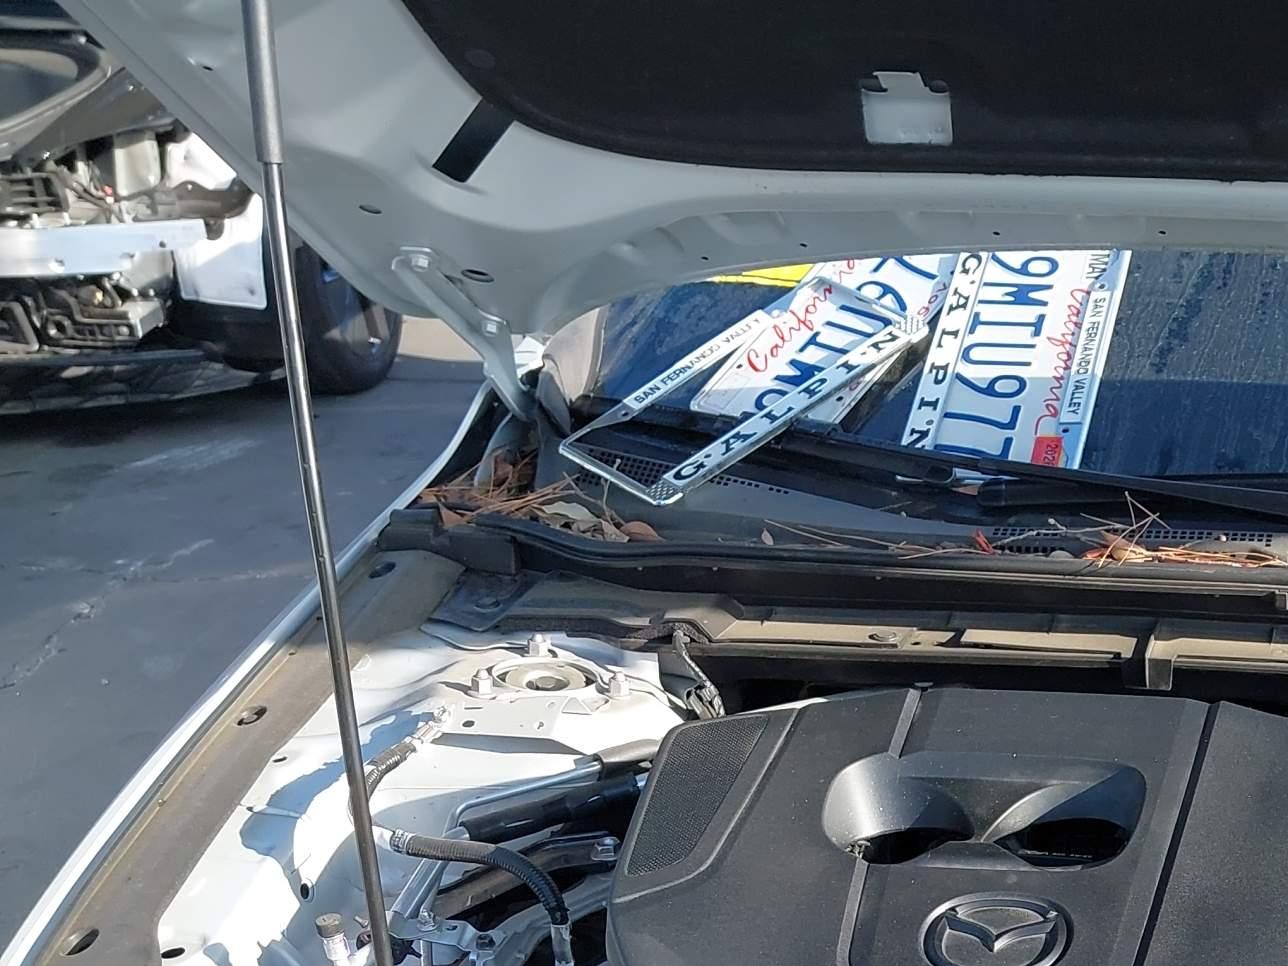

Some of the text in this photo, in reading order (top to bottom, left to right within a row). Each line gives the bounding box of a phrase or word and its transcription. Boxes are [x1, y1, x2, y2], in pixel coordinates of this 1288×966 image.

[1085, 253, 1111, 281] MAY
[633, 384, 662, 404] SAN
[672, 329, 903, 481] GALPIN
[909, 253, 983, 450] GALPIN
[1034, 288, 1092, 436] California
[1066, 297, 1106, 416] SAN FERNANDO VALLEY
